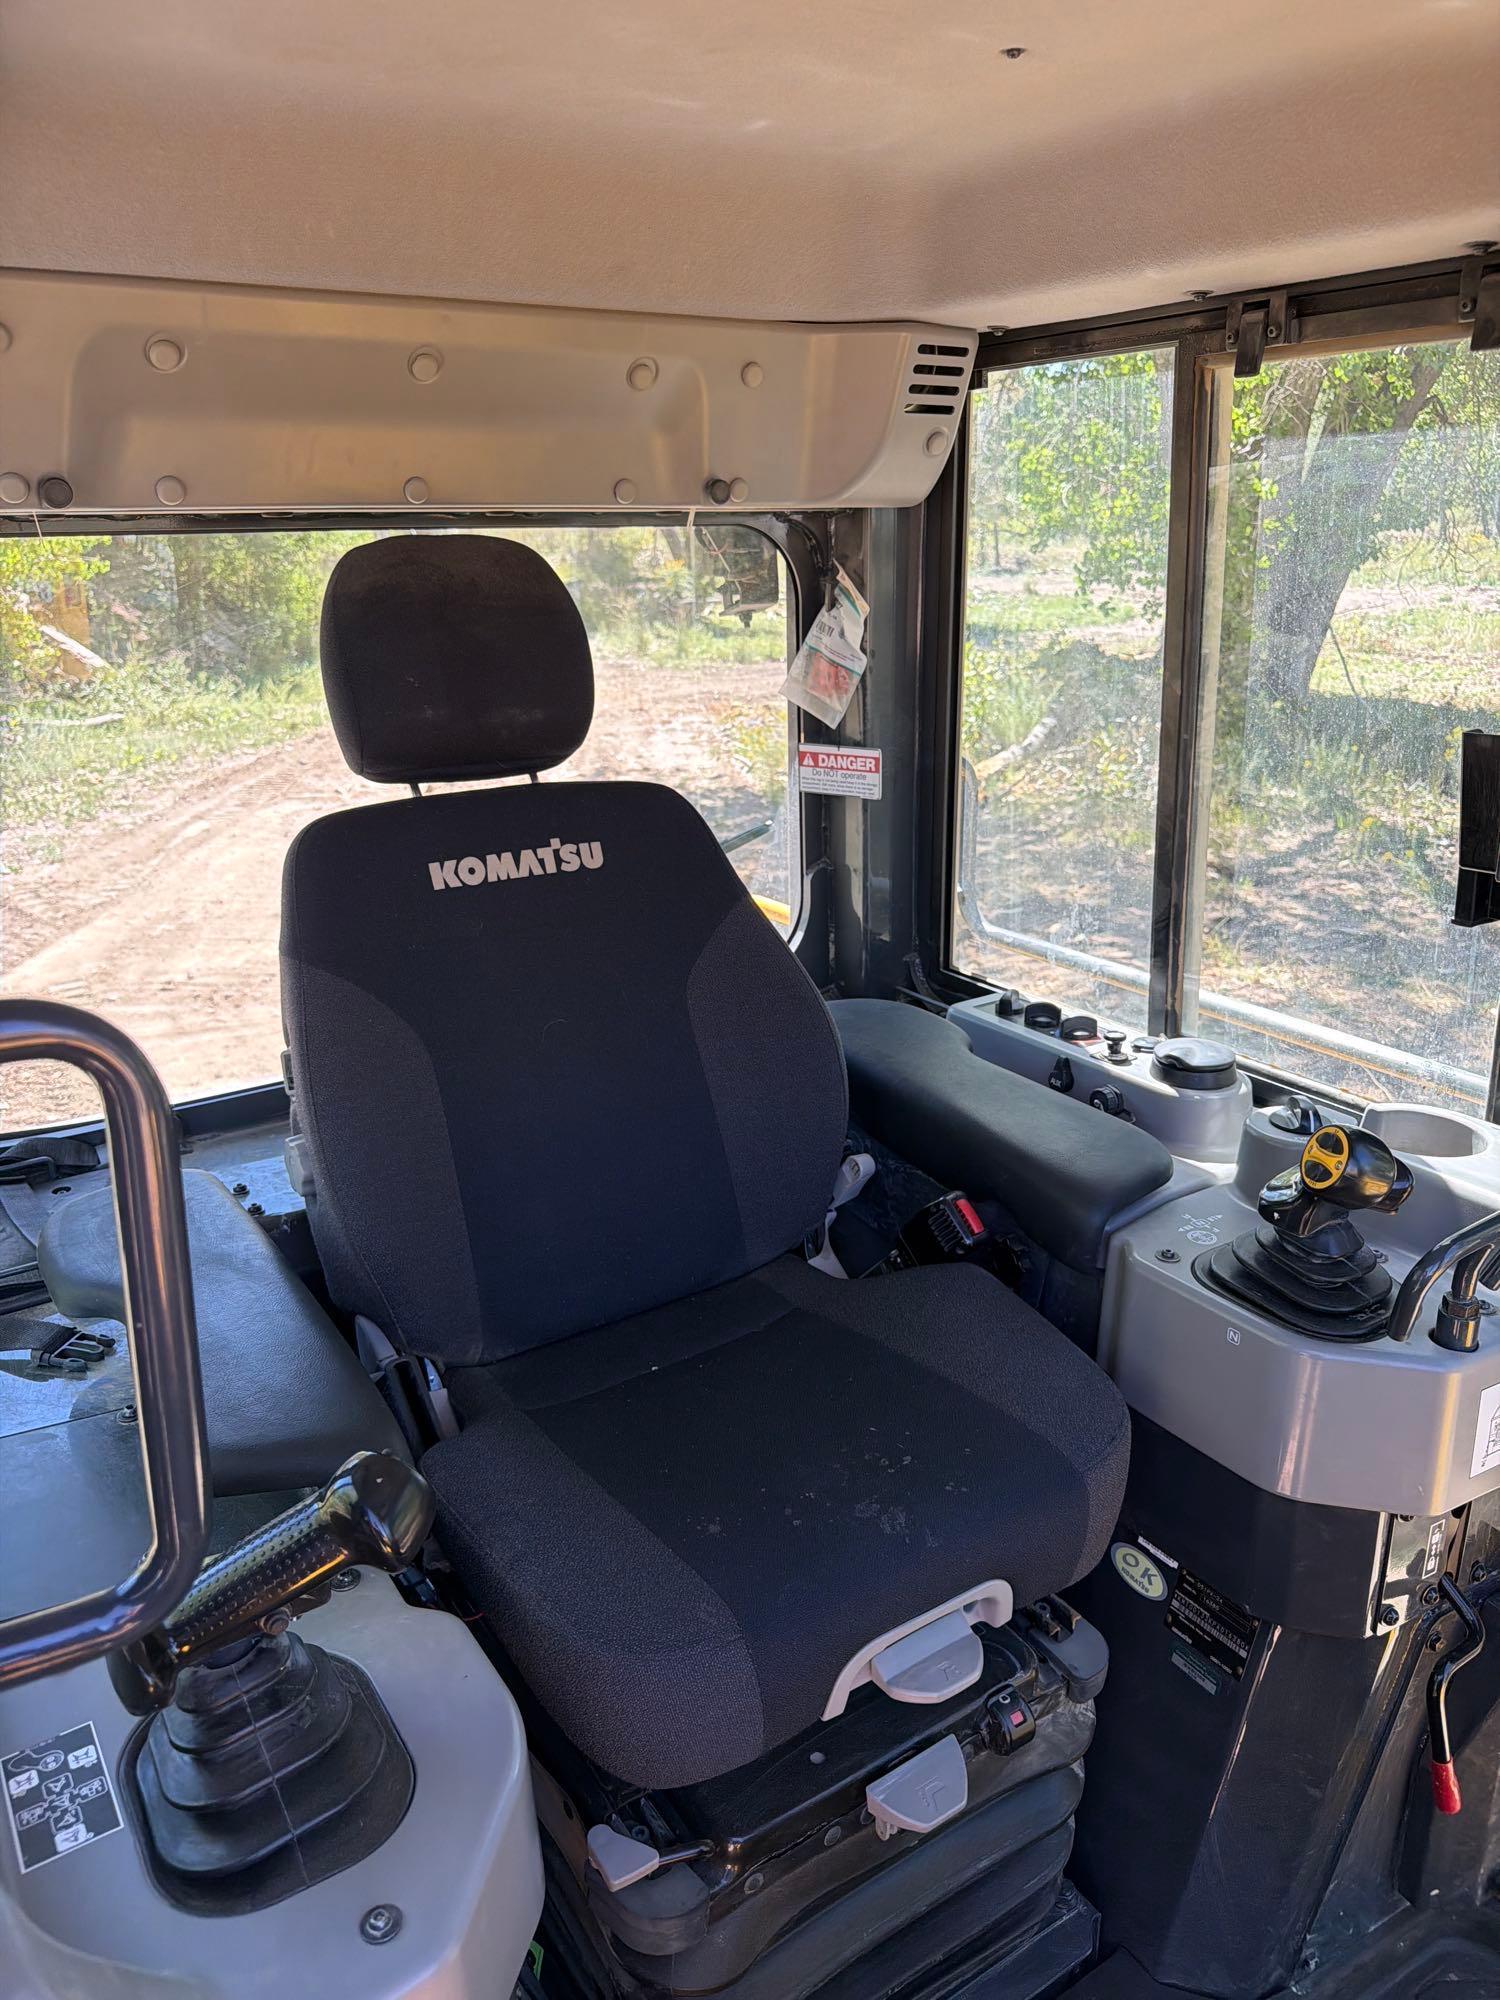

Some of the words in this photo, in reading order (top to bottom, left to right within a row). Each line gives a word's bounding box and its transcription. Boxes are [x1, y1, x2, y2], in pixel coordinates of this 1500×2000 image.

[818, 754, 876, 771] DANGER
[812, 768, 822, 777] Do
[824, 769, 839, 778] NOT
[840, 771, 867, 781] operate
[428, 837, 604, 891] KOMATSU
